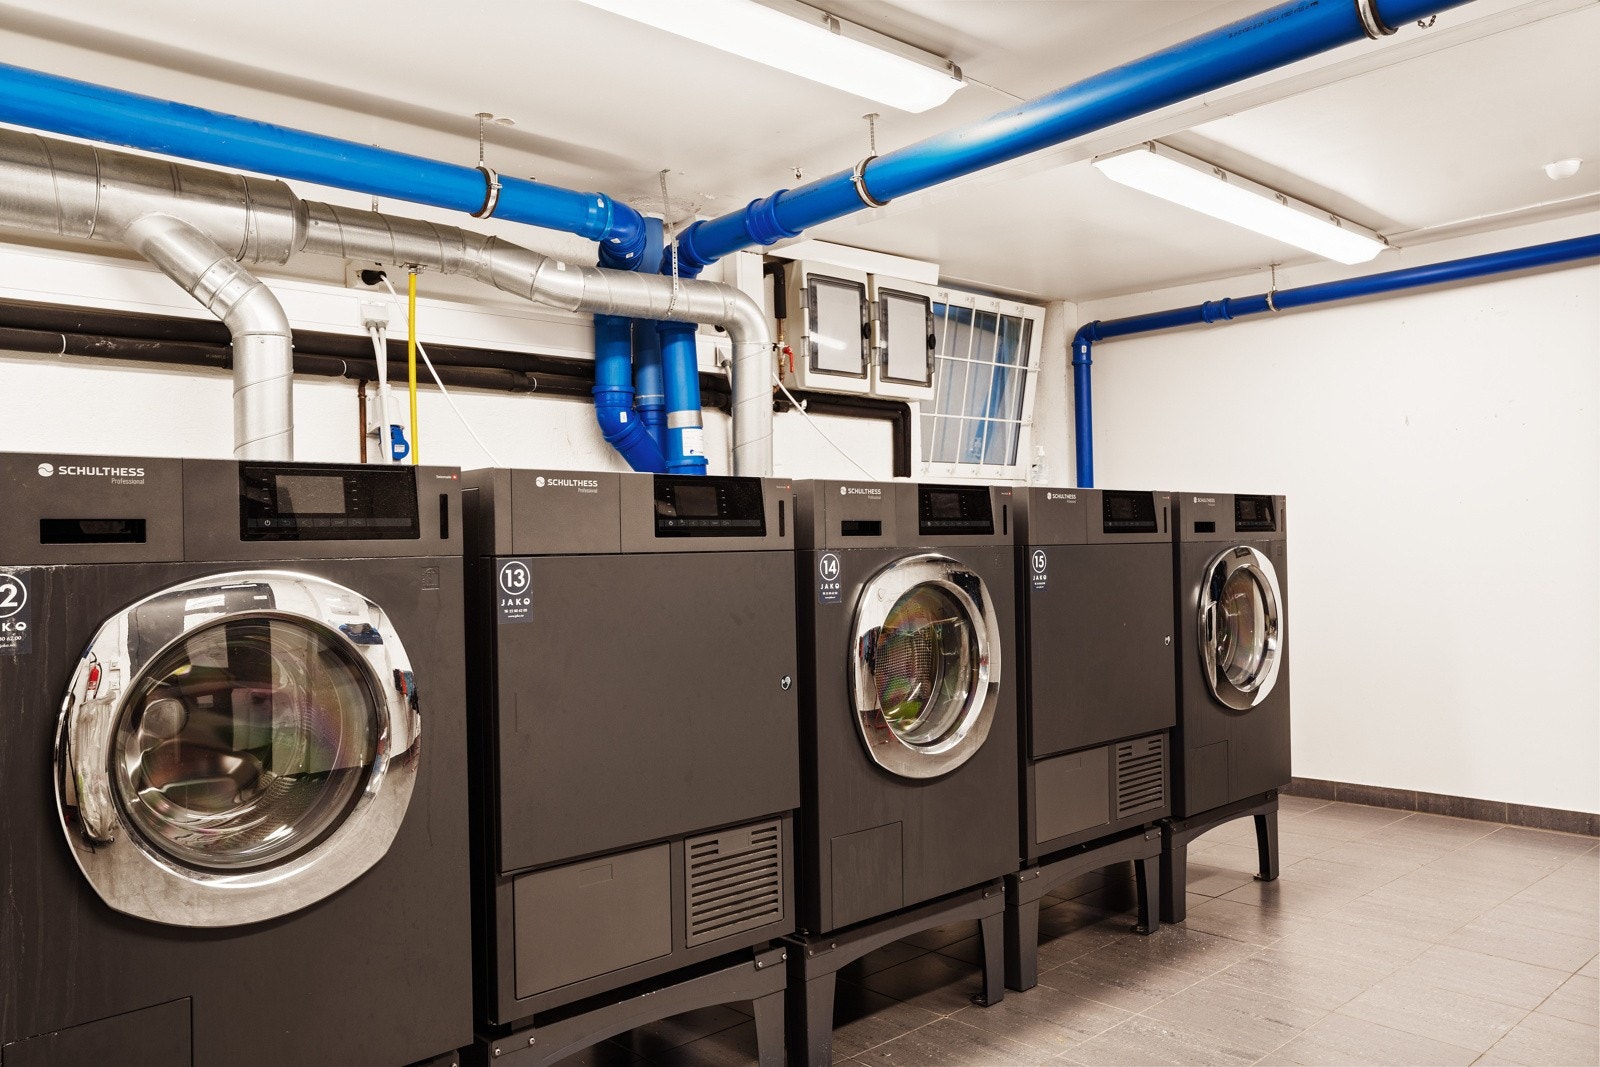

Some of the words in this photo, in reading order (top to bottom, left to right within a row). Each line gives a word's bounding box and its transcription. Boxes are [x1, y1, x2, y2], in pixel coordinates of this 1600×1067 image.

[58, 466, 145, 477] SCHULTHESS
[547, 478, 598, 487] SCHULTHESS
[847, 487, 882, 495] SCHULTHESS
[1034, 555, 1045, 568] 15
[823, 559, 837, 575] 14
[505, 568, 526, 588] 13
[820, 582, 840, 590] JAKO
[500, 597, 531, 607] JAKO
